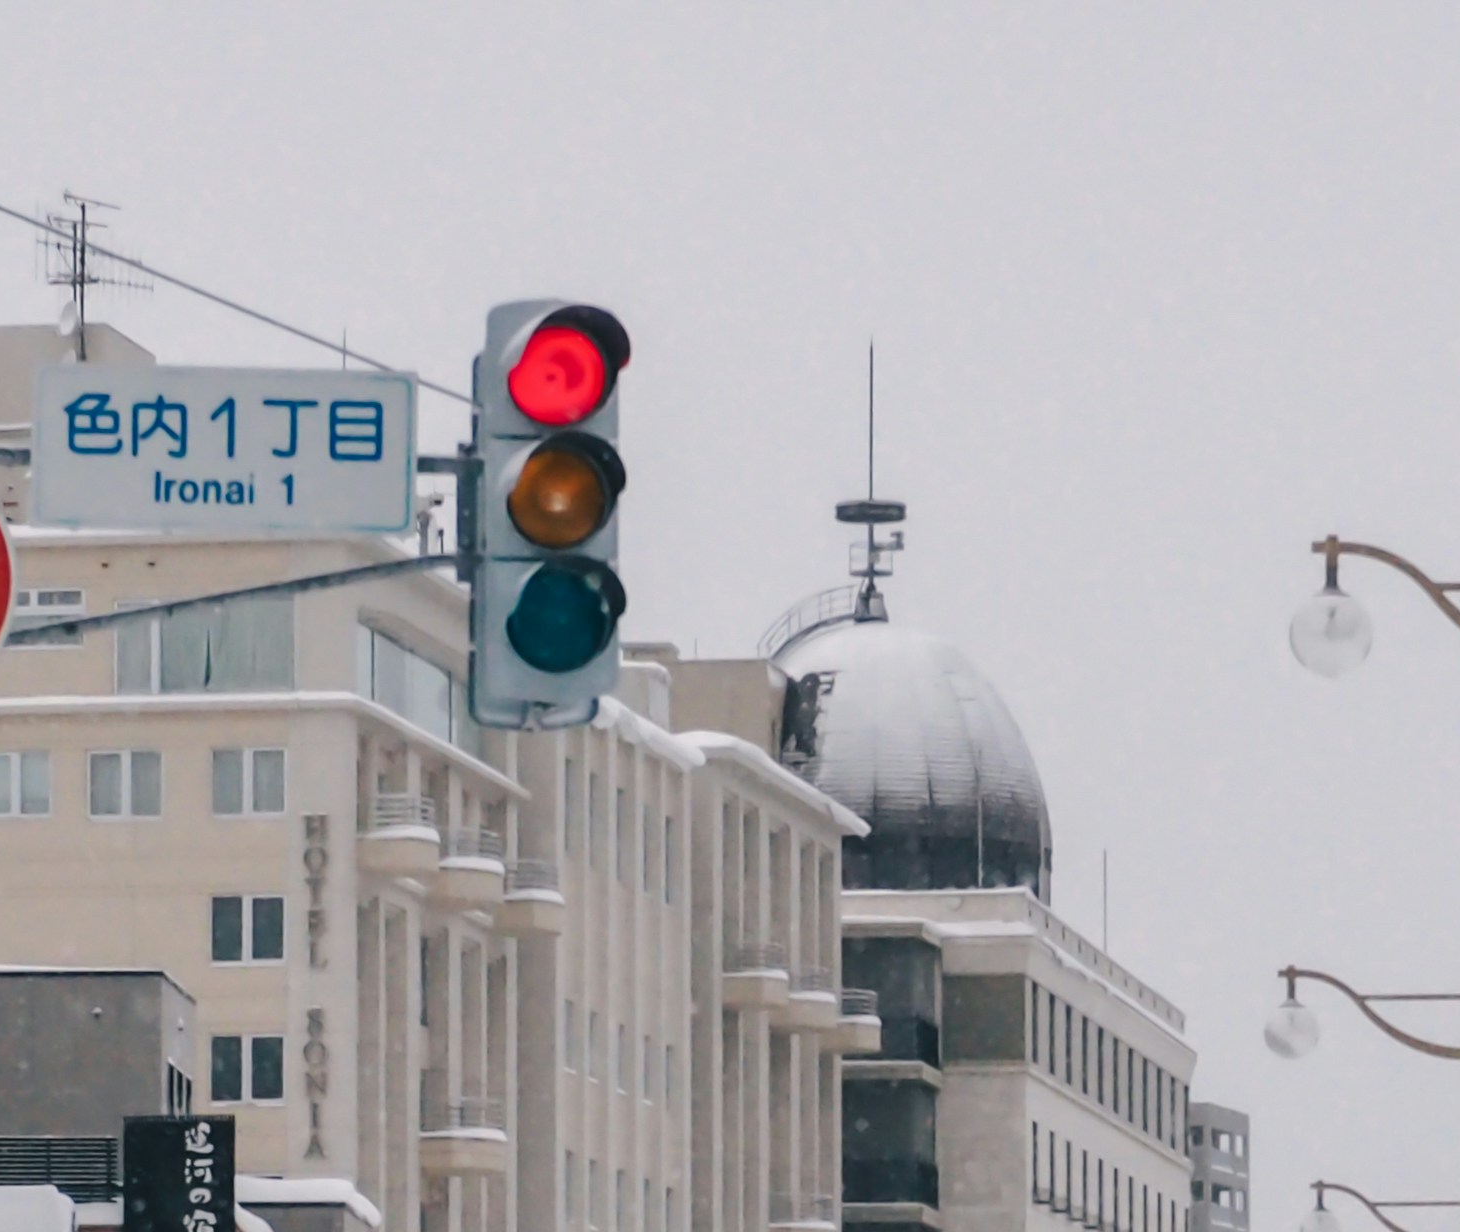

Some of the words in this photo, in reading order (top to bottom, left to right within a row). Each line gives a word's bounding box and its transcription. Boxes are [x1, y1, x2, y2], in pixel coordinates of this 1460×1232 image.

[63, 393, 383, 461] 色内1丁目
[154, 471, 254, 505] Ironai
[281, 473, 295, 506] 1
[303, 814, 328, 971] HOTEL
[303, 1008, 328, 1160] SONIA
